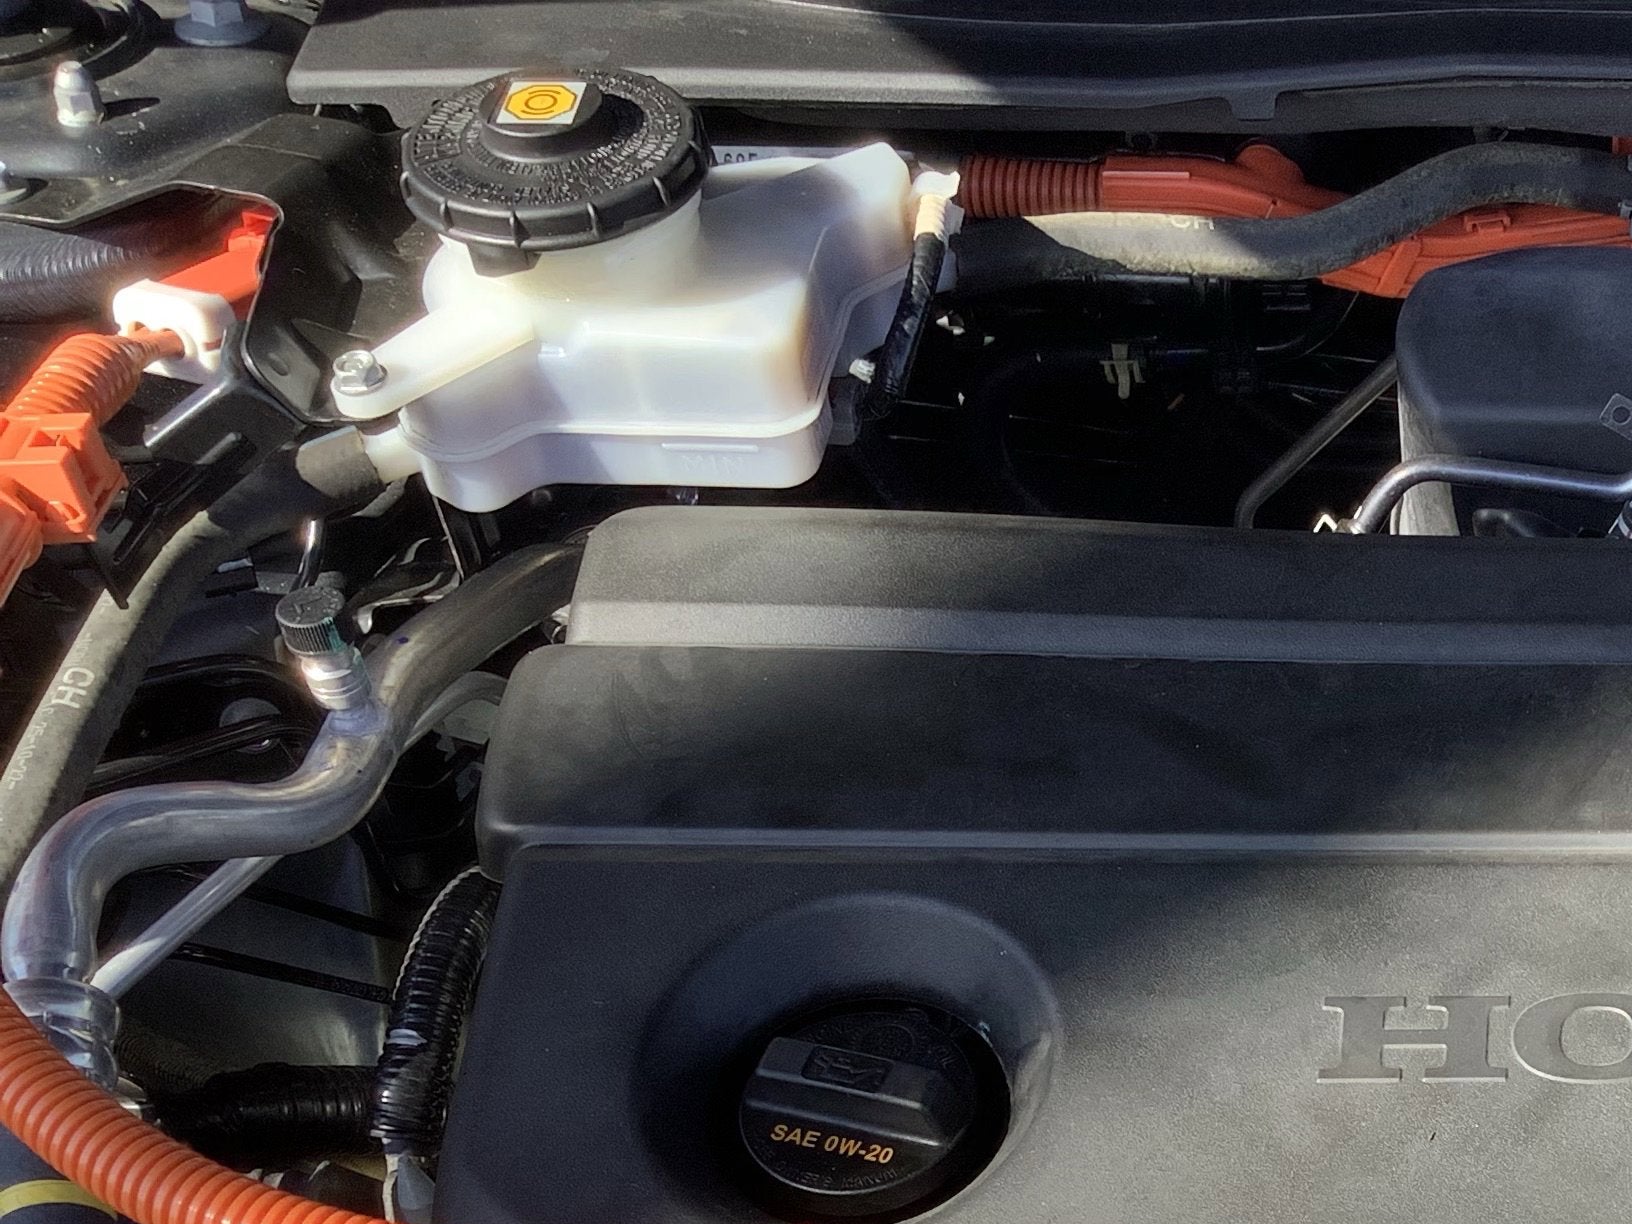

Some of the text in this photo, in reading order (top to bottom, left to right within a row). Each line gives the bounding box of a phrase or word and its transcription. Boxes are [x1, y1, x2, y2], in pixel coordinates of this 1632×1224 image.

[52, 667, 95, 709] CH
[770, 1124, 894, 1164] SAE 0W-20
